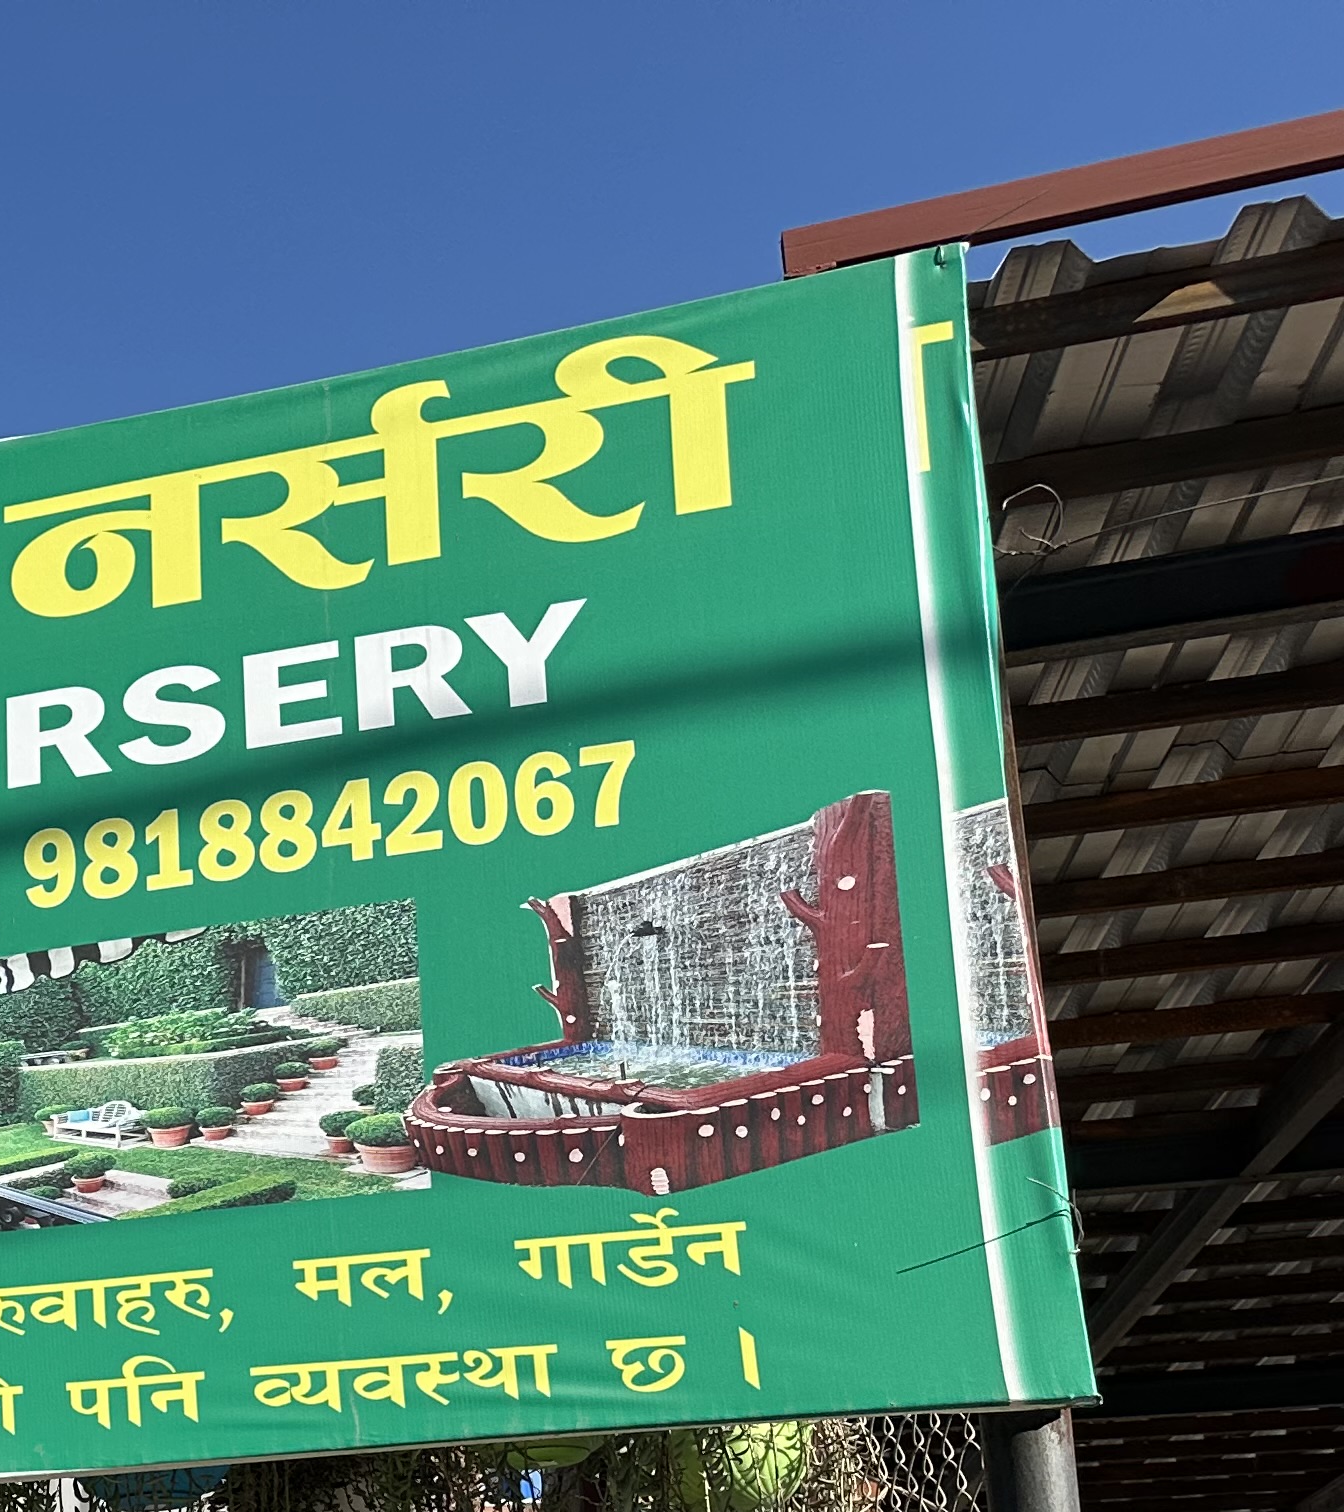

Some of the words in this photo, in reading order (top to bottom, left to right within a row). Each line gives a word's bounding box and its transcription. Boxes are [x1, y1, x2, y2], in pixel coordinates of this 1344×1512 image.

[4, 334, 756, 617] नर्सरी
[24, 741, 635, 908] 9818842067
[292, 1247, 455, 1314] मल,
[514, 1207, 746, 1288] गार्डेन
[66, 1355, 205, 1430] पनि
[249, 1344, 559, 1413] व्यवस्था
[605, 1334, 687, 1394] छ
